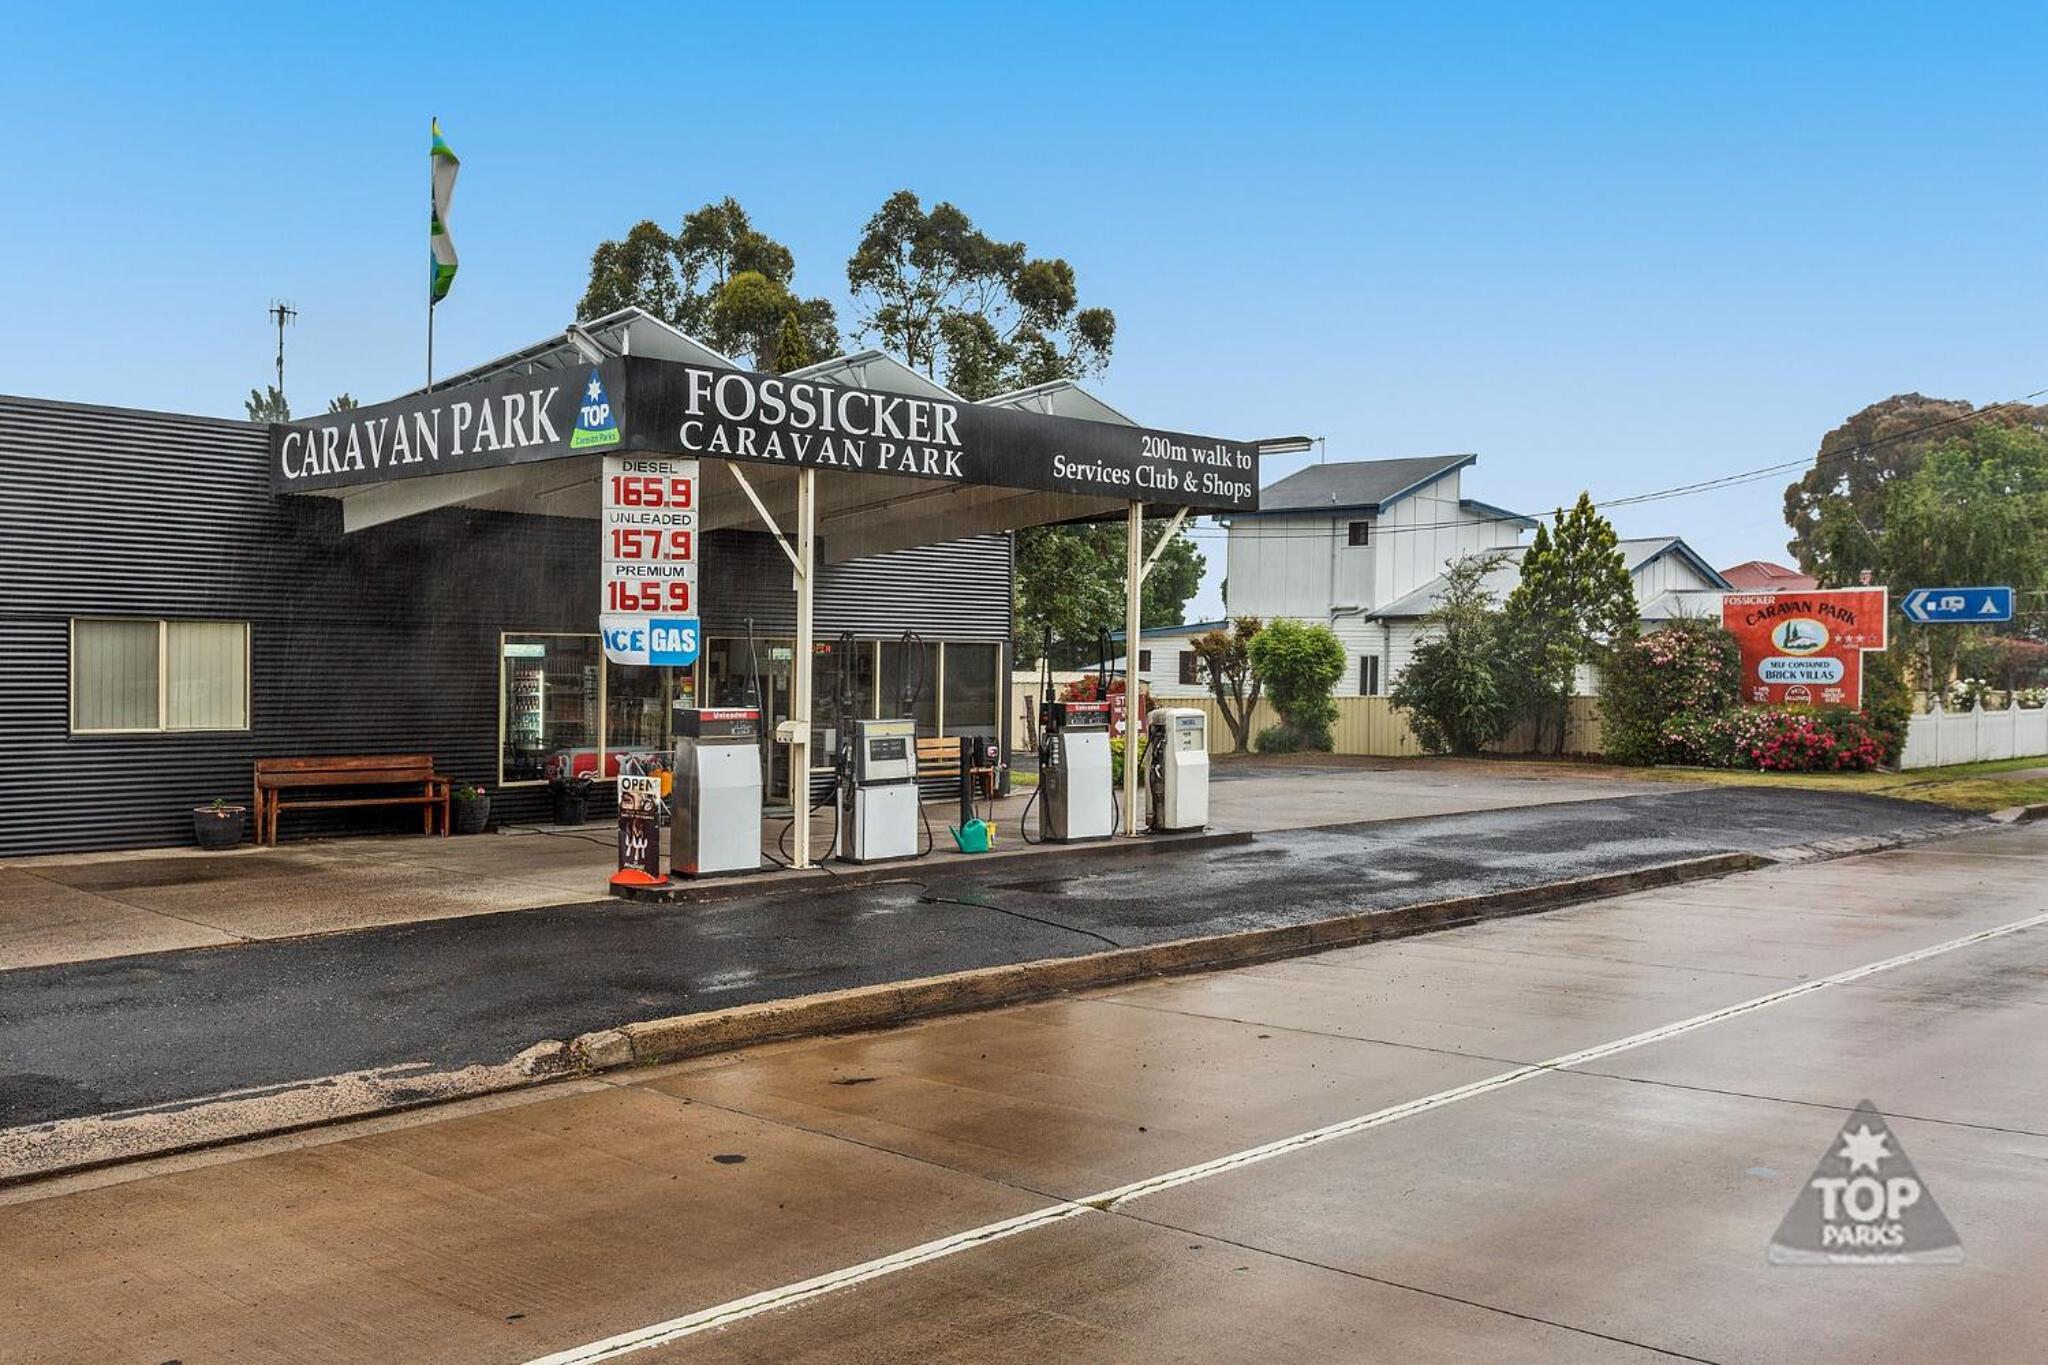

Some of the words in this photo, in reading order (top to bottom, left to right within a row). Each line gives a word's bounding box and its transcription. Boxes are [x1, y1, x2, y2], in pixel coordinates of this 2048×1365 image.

[581, 403, 610, 427] TOP
[684, 367, 962, 447] FOSSICKER
[281, 408, 441, 479] CARAVAN
[450, 386, 561, 456] PARK
[679, 421, 866, 468] CARAVAN
[877, 442, 964, 477] PARK
[1142, 435, 1188, 462] 200m
[1191, 445, 1232, 467] walk
[1236, 450, 1251, 470] to
[622, 461, 678, 473] DIESEL
[1053, 455, 1130, 485] Services
[1135, 465, 1178, 490] Club
[1183, 471, 1198, 493] &
[1202, 473, 1252, 503] Shops
[611, 476, 692, 508] 165.9
[610, 513, 692, 525] UNLEADED
[611, 529, 691, 560] 157.9
[616, 565, 685, 577] PREMIUM
[608, 581, 689, 612] 165.9
[1724, 595, 1775, 605] FOSSICKER
[1745, 602, 1812, 626] CARAVAN
[1818, 602, 1857, 625] PARK
[603, 628, 645, 652] ICE
[651, 628, 696, 652] GAS
[1765, 670, 1796, 679] BRICK
[1800, 670, 1834, 679] VILLAS
